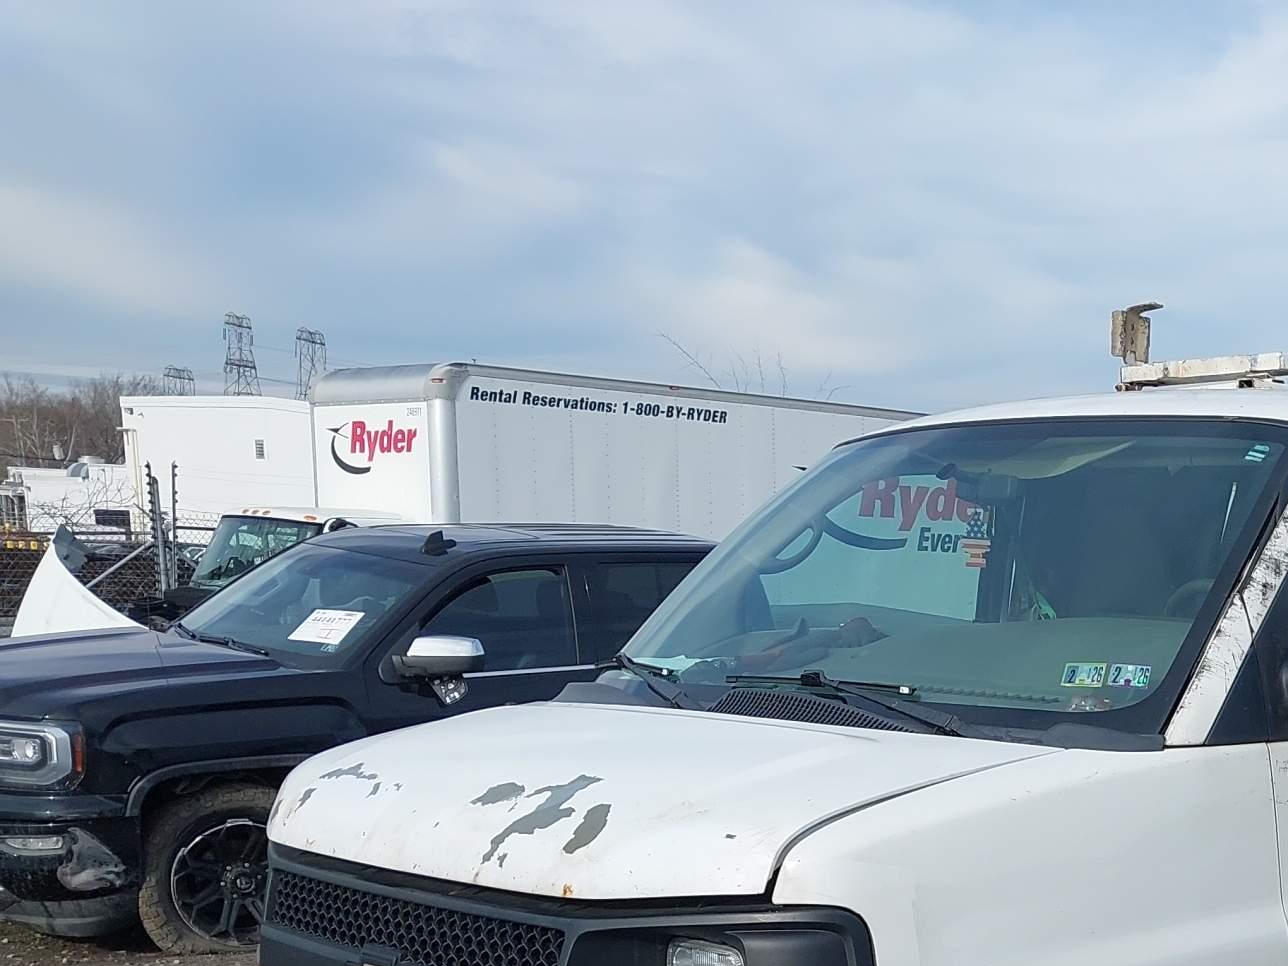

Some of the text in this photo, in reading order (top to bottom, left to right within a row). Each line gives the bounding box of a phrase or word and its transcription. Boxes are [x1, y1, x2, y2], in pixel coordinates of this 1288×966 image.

[470, 386, 728, 424] Rental Reservations: 1-800-BY-RYDER
[350, 419, 418, 462] Ryder
[917, 526, 962, 553] Ever
